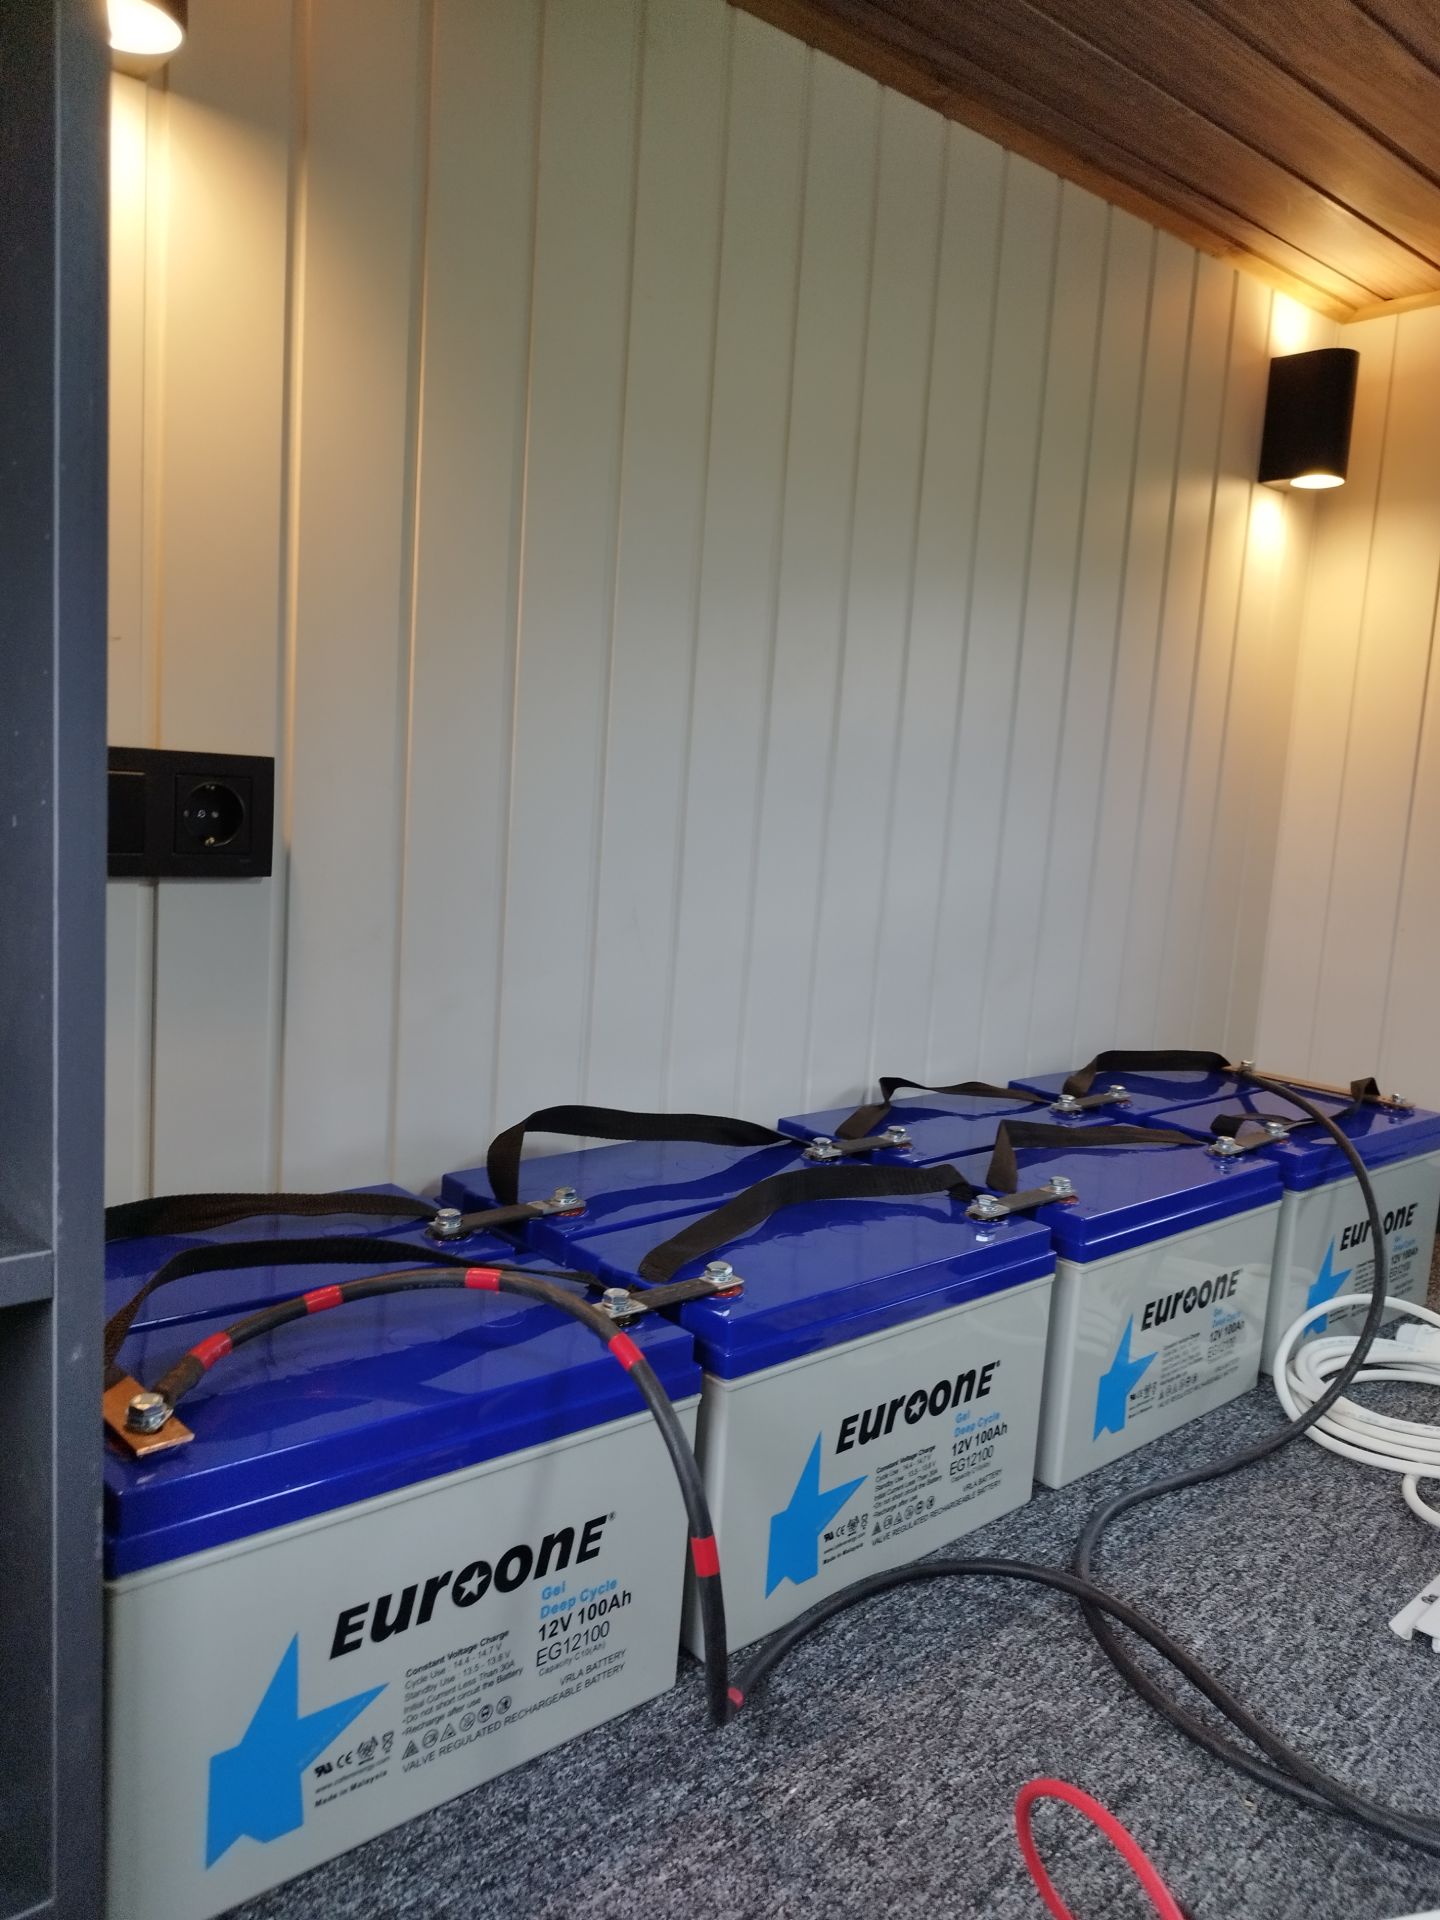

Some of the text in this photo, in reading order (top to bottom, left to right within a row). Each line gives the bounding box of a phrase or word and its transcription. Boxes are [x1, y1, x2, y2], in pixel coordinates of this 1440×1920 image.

[952, 1422, 1008, 1456] 12V 100Ah
[949, 1445, 994, 1476] EG12100
[540, 1579, 618, 1620] Deep Cycle
[541, 1580, 566, 1601] Gel
[539, 1590, 632, 1641] 12V 100Ah
[405, 1630, 510, 1678] Constant Voltage Charge
[536, 1620, 610, 1668] EG12100
[496, 1667, 524, 1684] Battery
[560, 1648, 627, 1685] VRLA BATTERY
[402, 1662, 626, 1774] VALVE REGULATED RECHARGEABLE BATTERY
